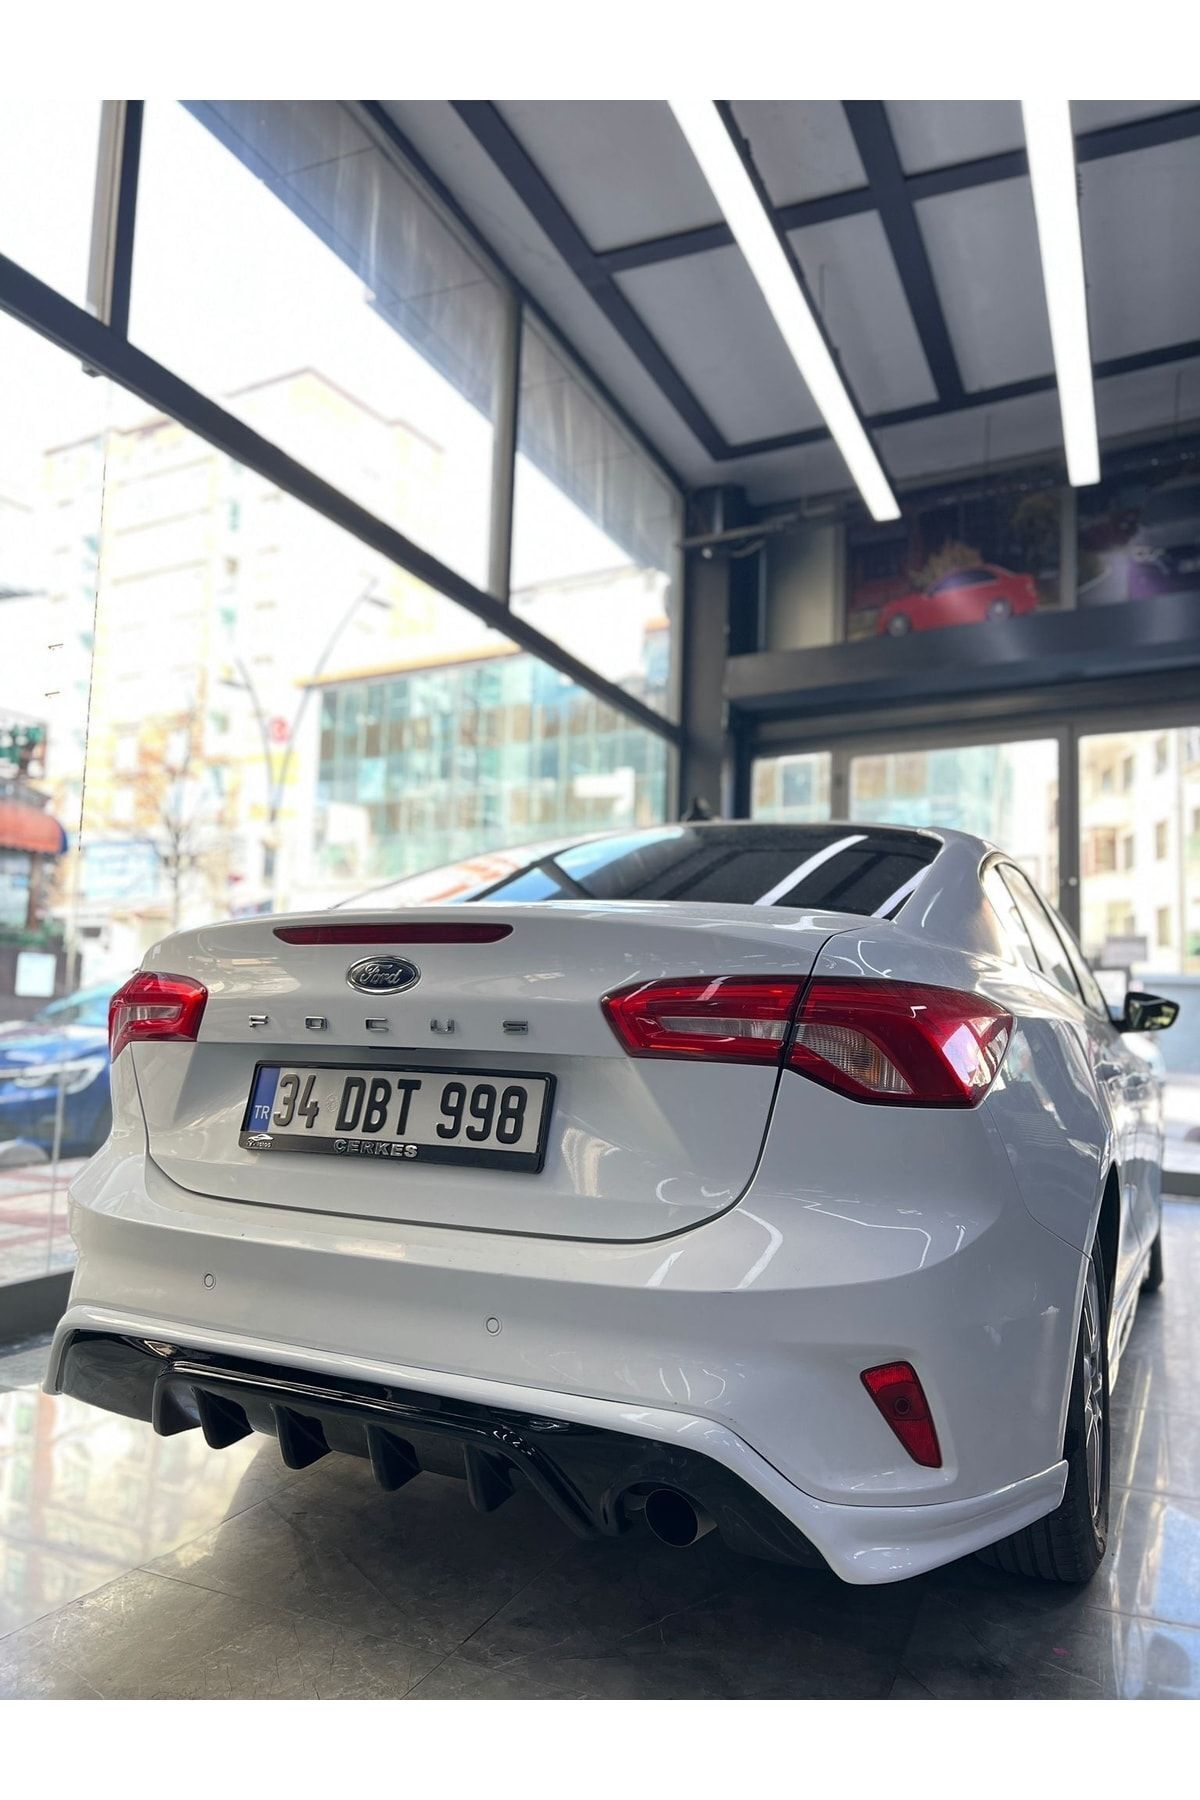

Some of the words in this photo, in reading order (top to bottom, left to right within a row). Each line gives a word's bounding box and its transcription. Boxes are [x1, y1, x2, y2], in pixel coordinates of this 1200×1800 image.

[360, 964, 402, 984] Ford
[249, 1014, 528, 1035] FOCUS
[254, 1105, 270, 1120] TR
[273, 1073, 319, 1129] 34
[335, 1076, 421, 1135] DBT
[436, 1081, 527, 1145] 998
